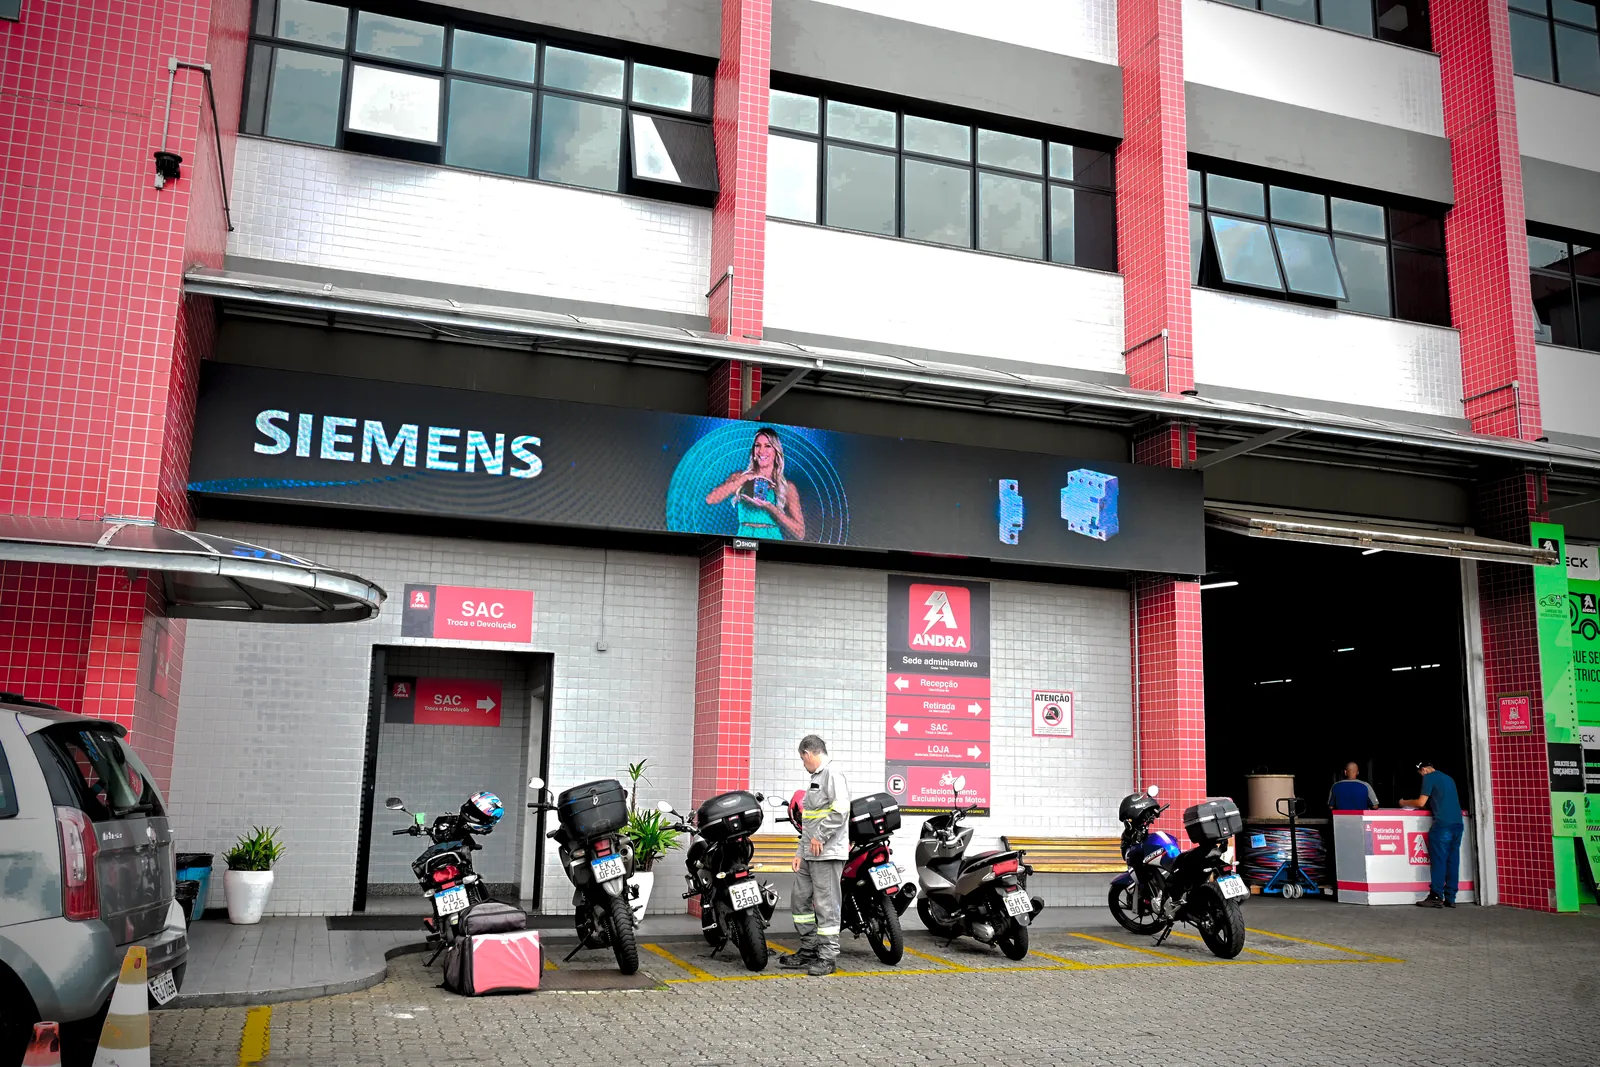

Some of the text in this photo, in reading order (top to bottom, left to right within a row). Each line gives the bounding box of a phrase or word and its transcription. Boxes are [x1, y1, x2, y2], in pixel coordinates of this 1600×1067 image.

[253, 409, 543, 479] SIEMENS
[461, 600, 504, 619] SAC
[447, 618, 468, 627] Troca
[477, 620, 517, 630] Devolução
[912, 633, 967, 648] ANDRA
[902, 656, 978, 668] Sede administrativa
[1588, 651, 1600, 664] SE
[920, 679, 958, 690] Recepção
[433, 694, 462, 705] SAC
[1035, 694, 1070, 703] ATENÇÃO
[1502, 698, 1526, 706] ATENÇÃO
[923, 701, 955, 710] Retirada
[930, 723, 948, 731] SAC
[927, 745, 949, 753] LOJA
[893, 779, 902, 790] E
[921, 787, 977, 795] Estacionento
[599, 859, 617, 871] EKJ
[876, 868, 892, 879] SUL
[734, 887, 755, 899] GFT
[442, 900, 465, 912] 4125
[736, 895, 759, 908] 2390
[1008, 896, 1026, 906] GHE
[1010, 904, 1030, 914] 9019
